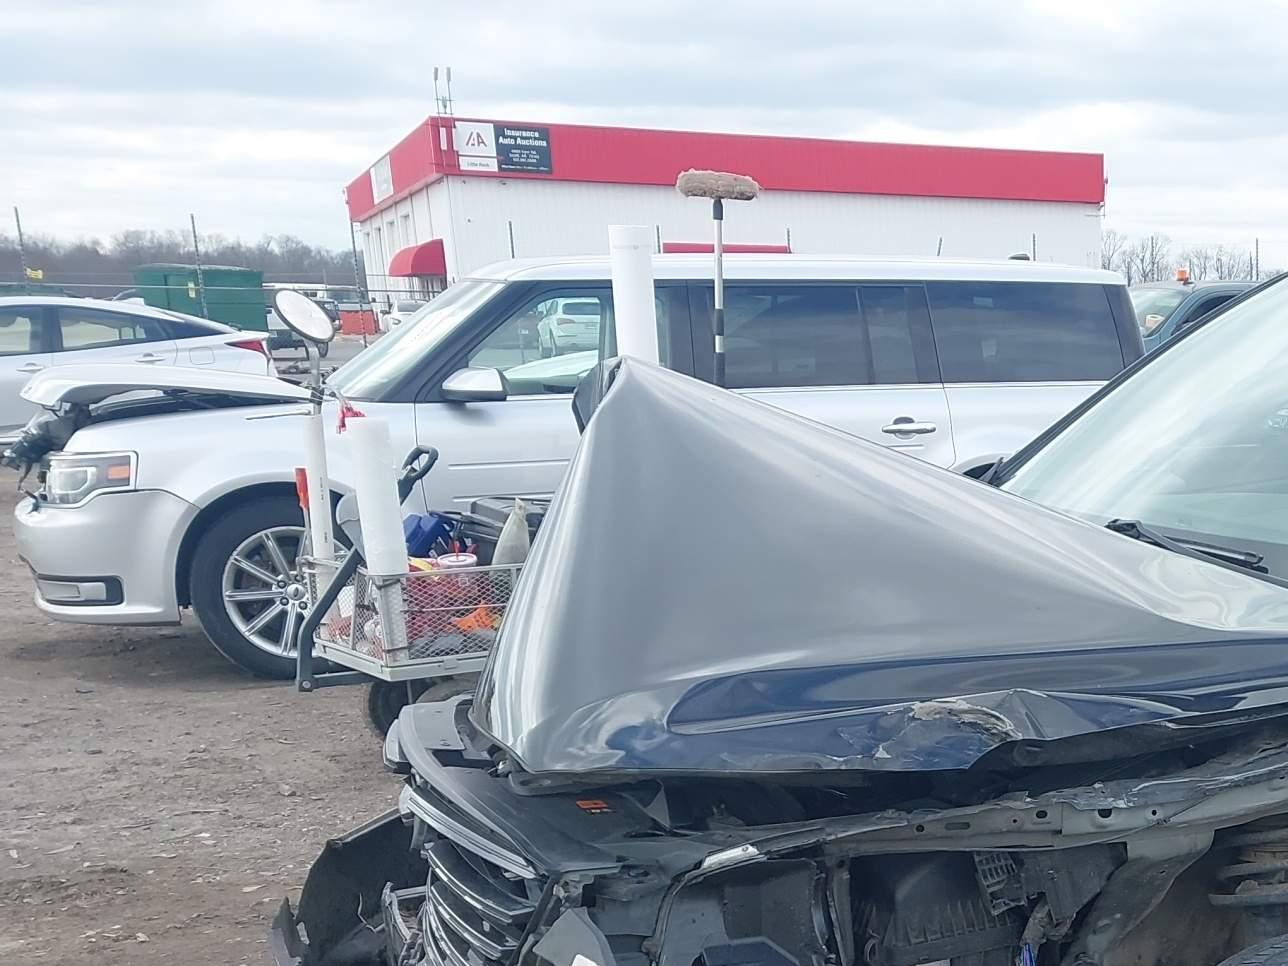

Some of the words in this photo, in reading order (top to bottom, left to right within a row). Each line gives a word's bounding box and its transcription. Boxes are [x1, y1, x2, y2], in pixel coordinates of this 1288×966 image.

[504, 128, 539, 138] Insurance
[498, 136, 515, 145] Auto
[516, 137, 547, 147] Auctions
